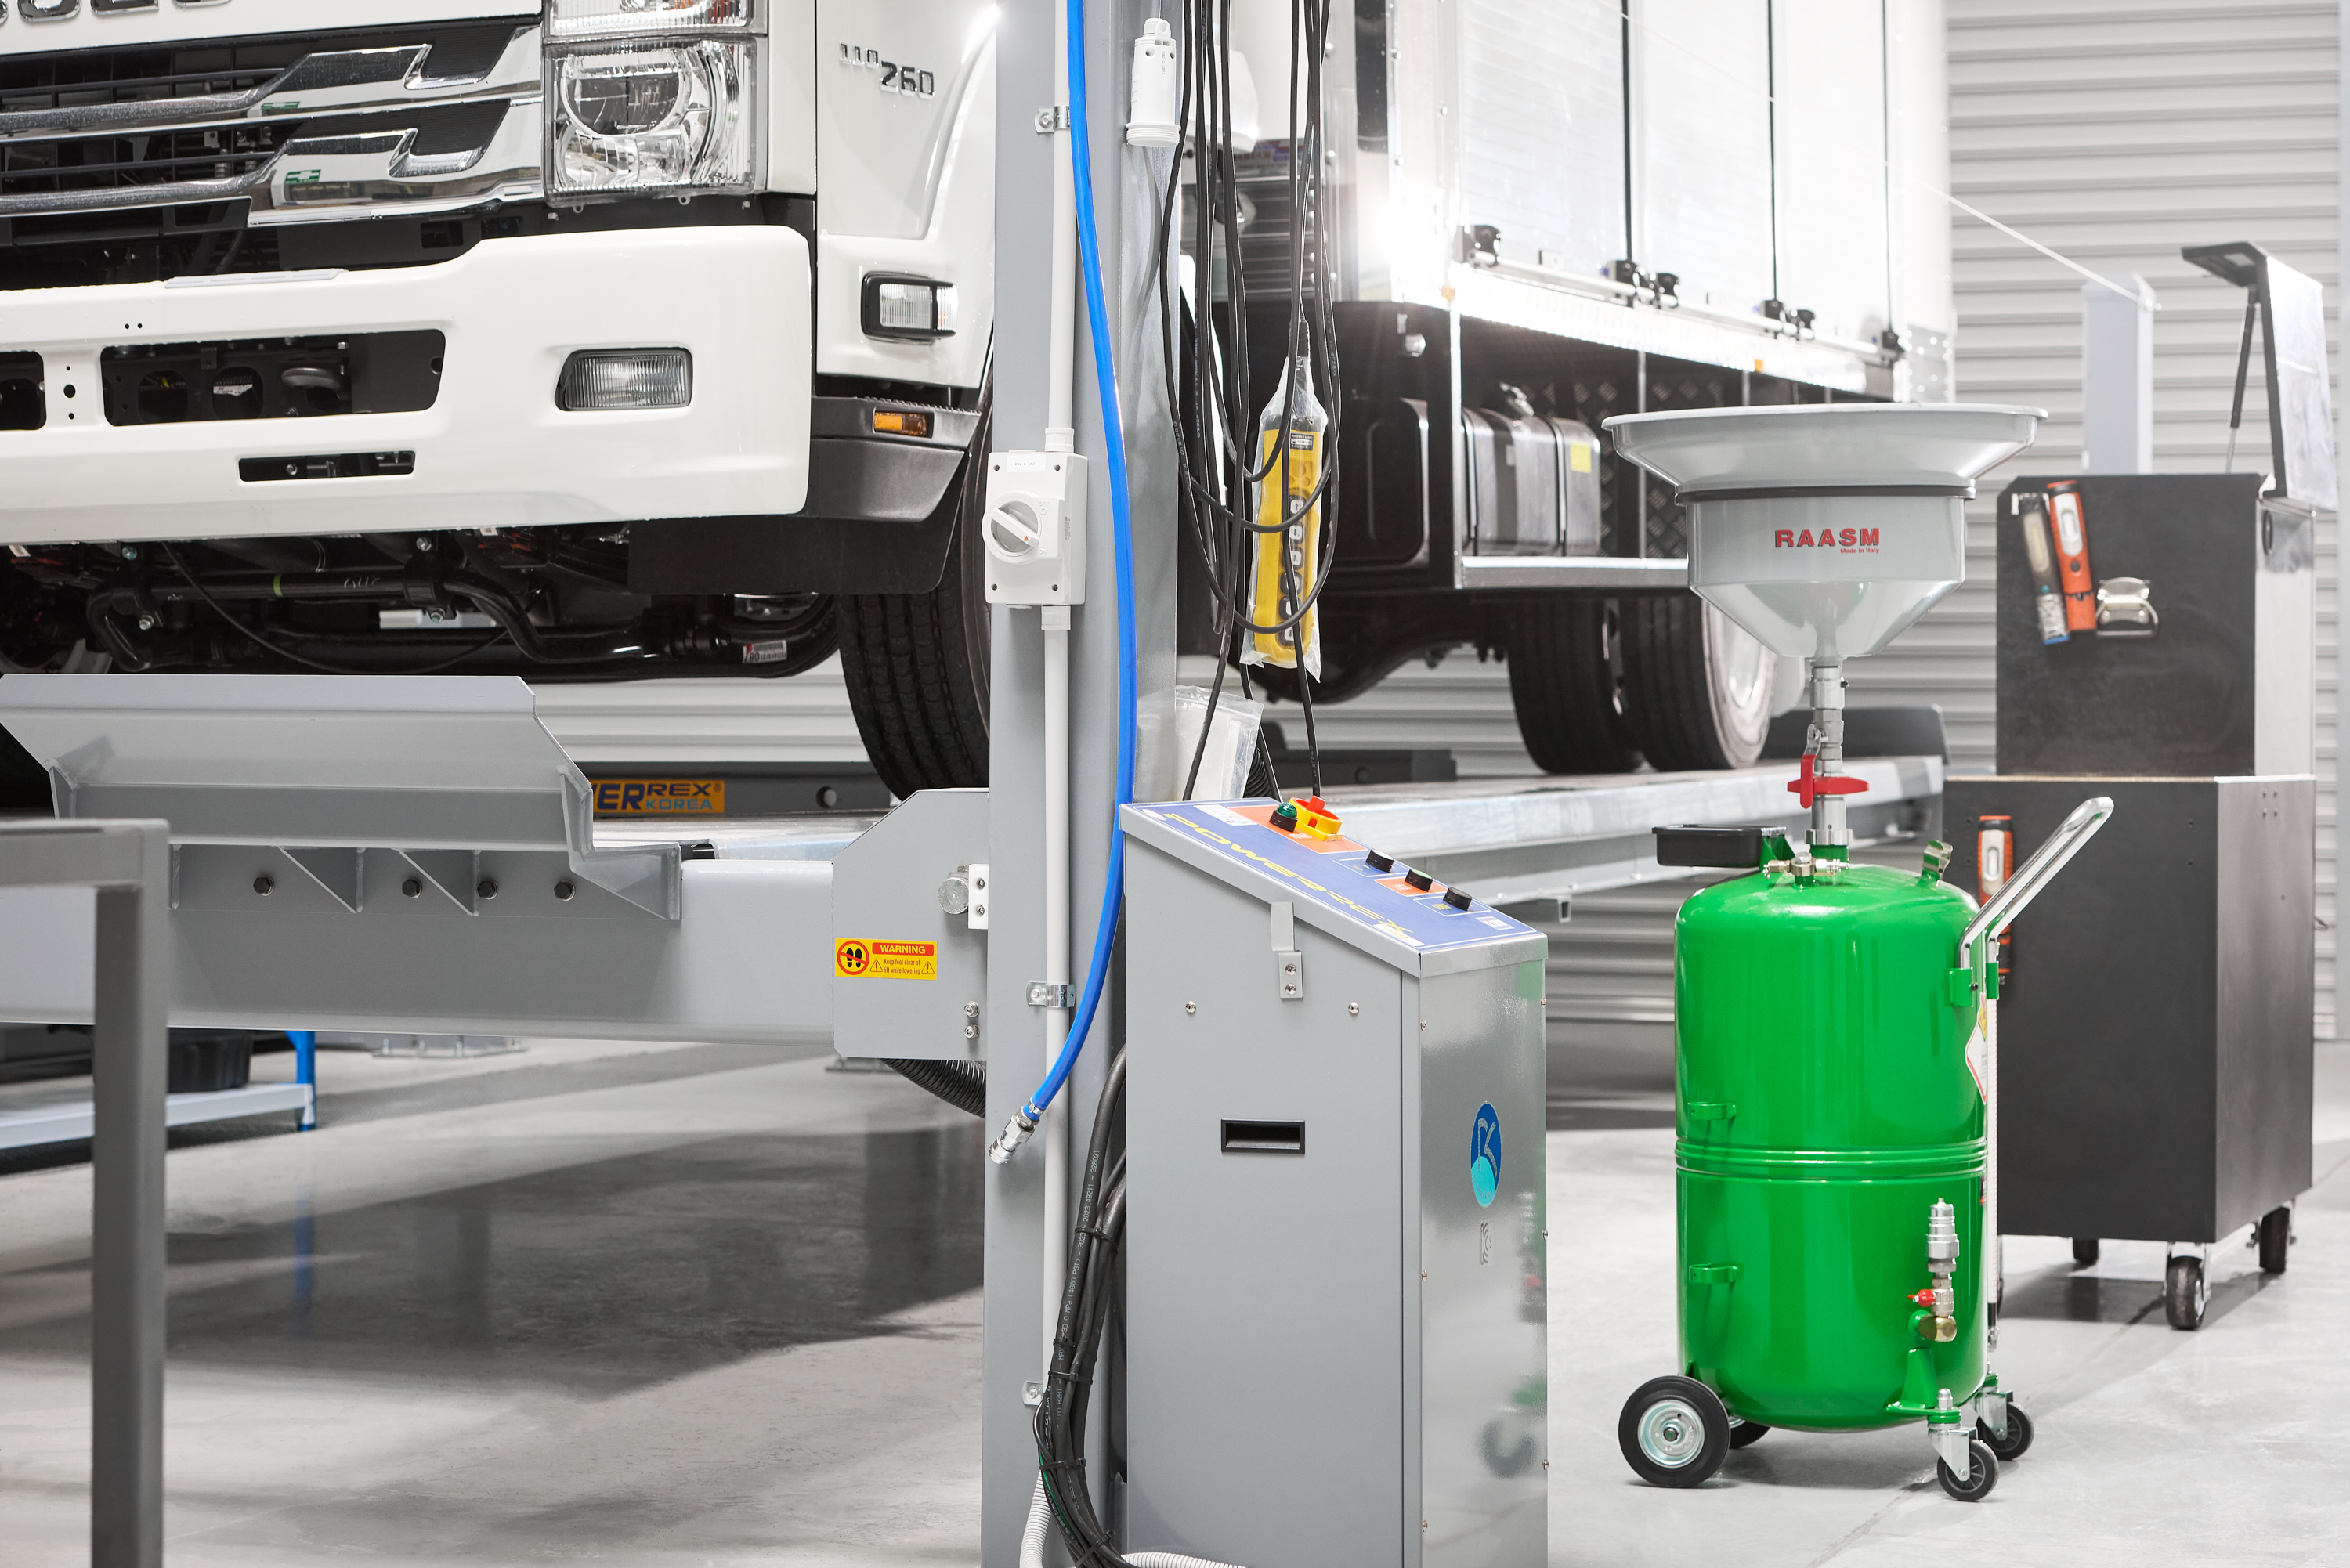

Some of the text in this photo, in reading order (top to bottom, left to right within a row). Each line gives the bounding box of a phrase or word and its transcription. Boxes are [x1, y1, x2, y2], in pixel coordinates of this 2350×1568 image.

[839, 42, 935, 99] 110 260
[1775, 528, 1879, 547] RAASM
[593, 784, 645, 810] ER
[645, 798, 714, 811] KOREA
[880, 945, 926, 954] WARNING
[1068, 1277, 1077, 1297] (4800
[1083, 1184, 1094, 1222] 2023_43211
[1090, 1150, 1099, 1172] 328021
